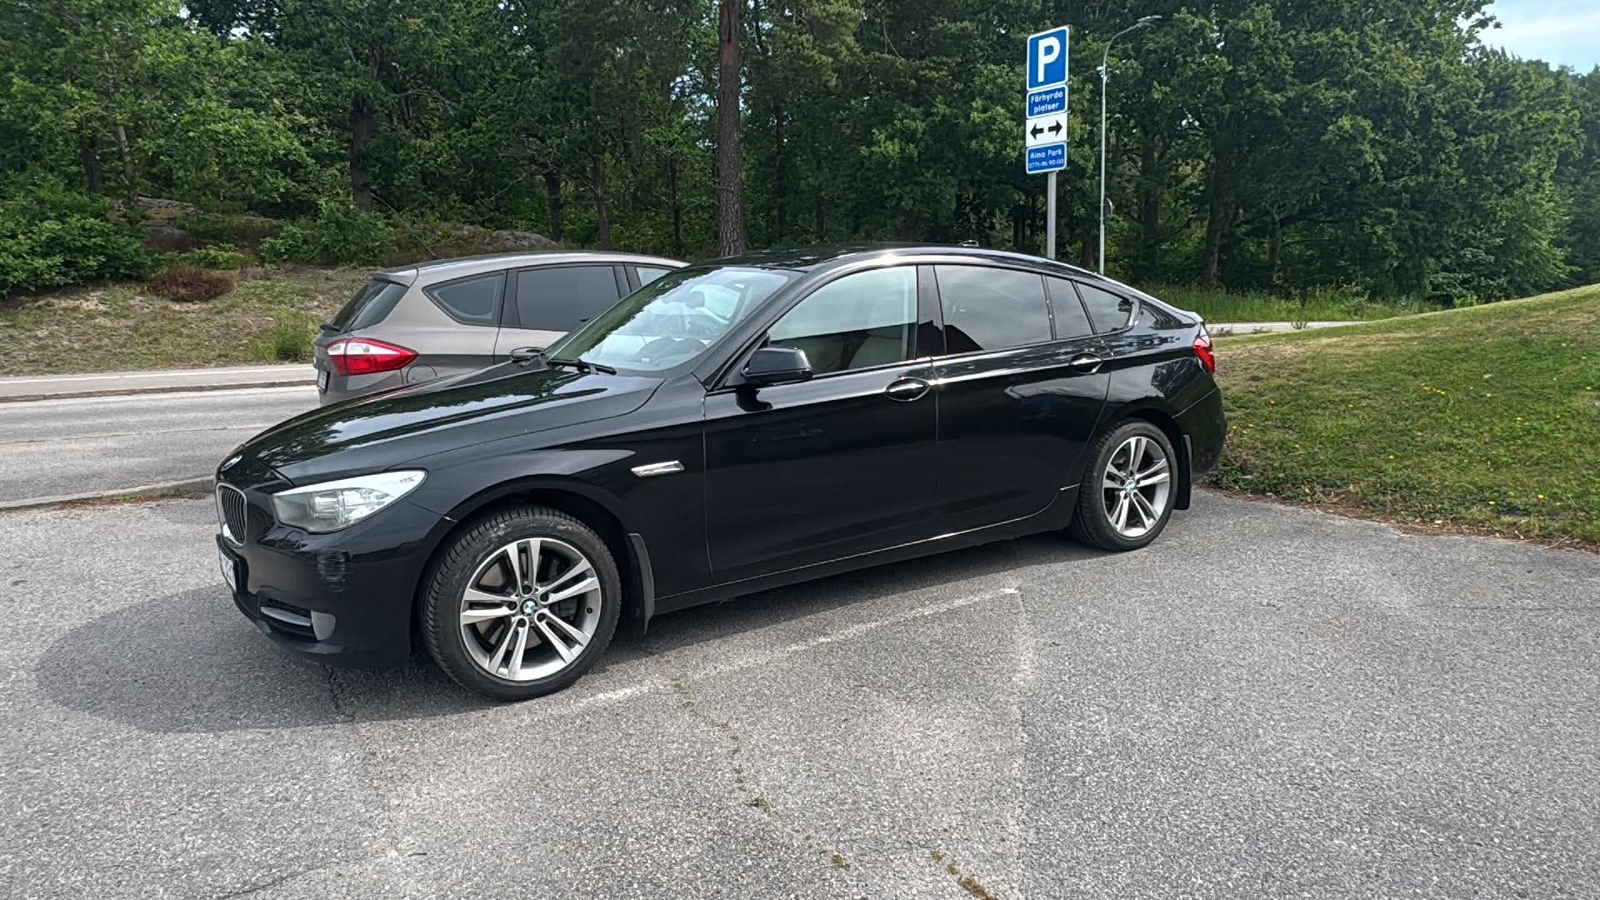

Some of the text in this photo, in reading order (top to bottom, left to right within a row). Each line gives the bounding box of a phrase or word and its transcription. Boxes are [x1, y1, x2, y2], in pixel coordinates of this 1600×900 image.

[1037, 36, 1061, 83] P
[1033, 102, 1059, 114] platser
[1047, 148, 1062, 156] Park
